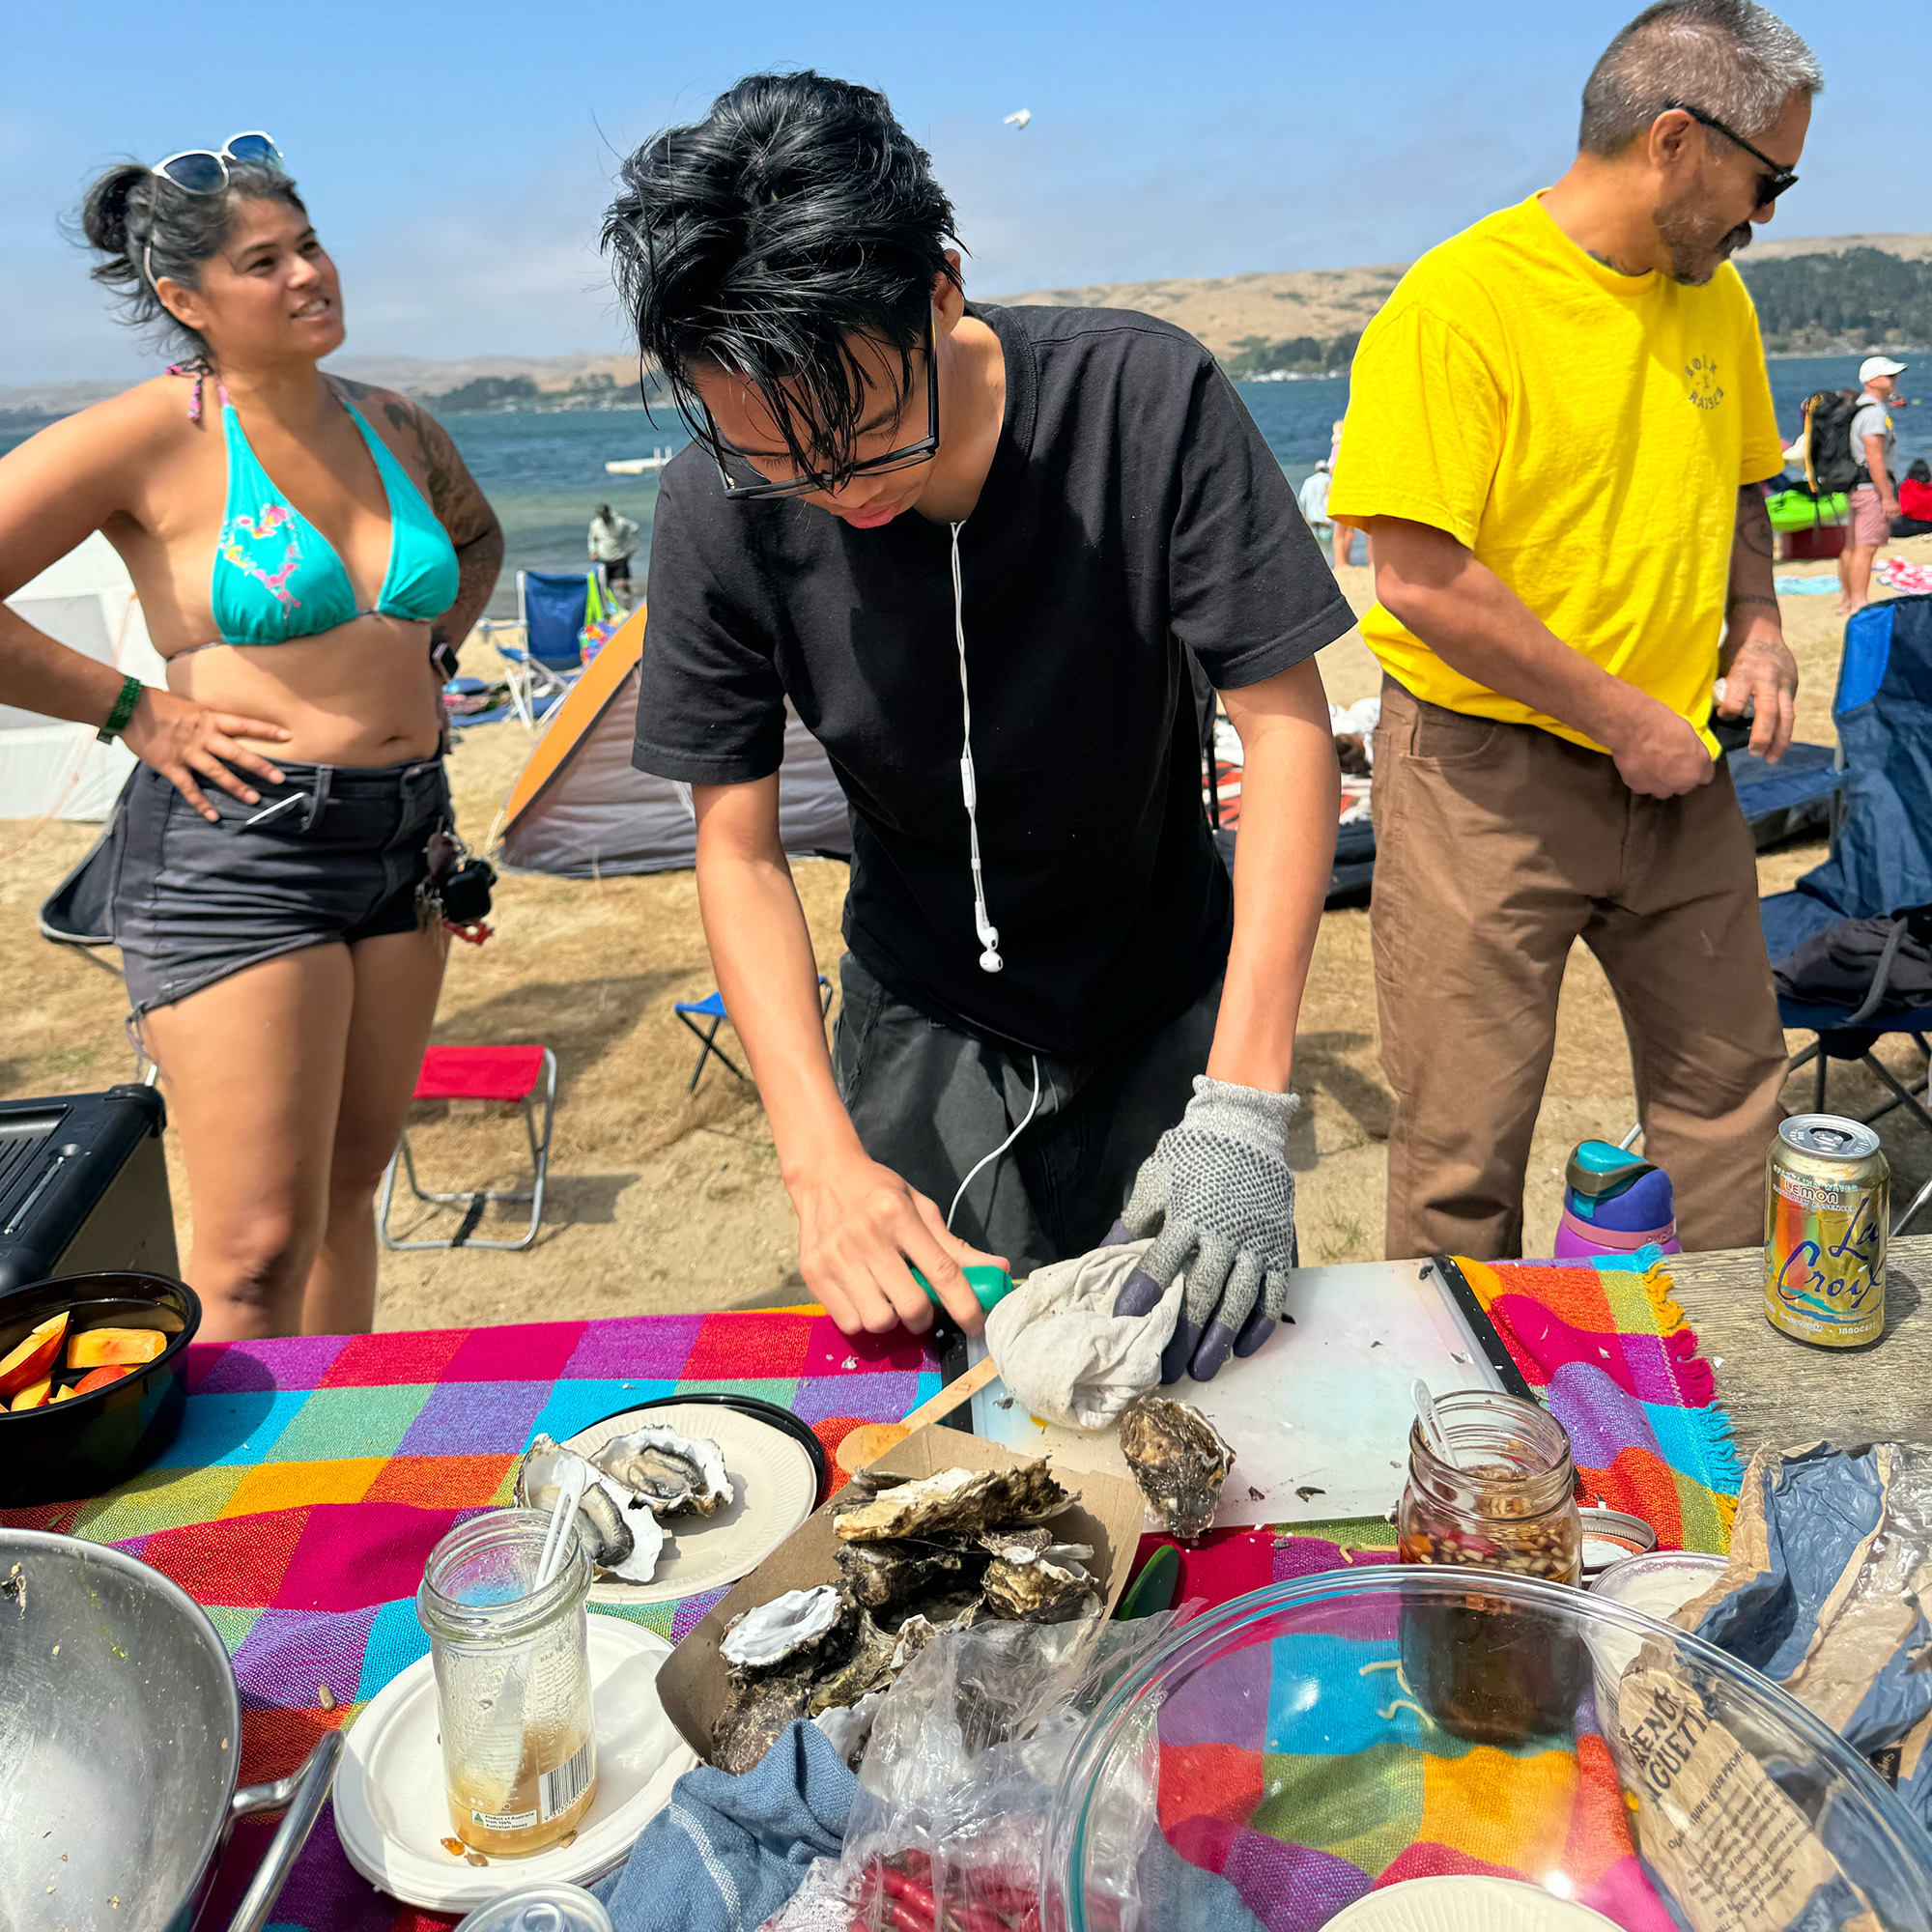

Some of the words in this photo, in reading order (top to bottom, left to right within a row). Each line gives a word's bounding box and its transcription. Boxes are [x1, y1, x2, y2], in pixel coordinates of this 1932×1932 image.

[1785, 1179, 1839, 1205] LEMON
[1825, 1184, 1859, 1193] WATER
[1829, 1197, 1880, 1261] La
[1776, 1240, 1885, 1308] Croix
